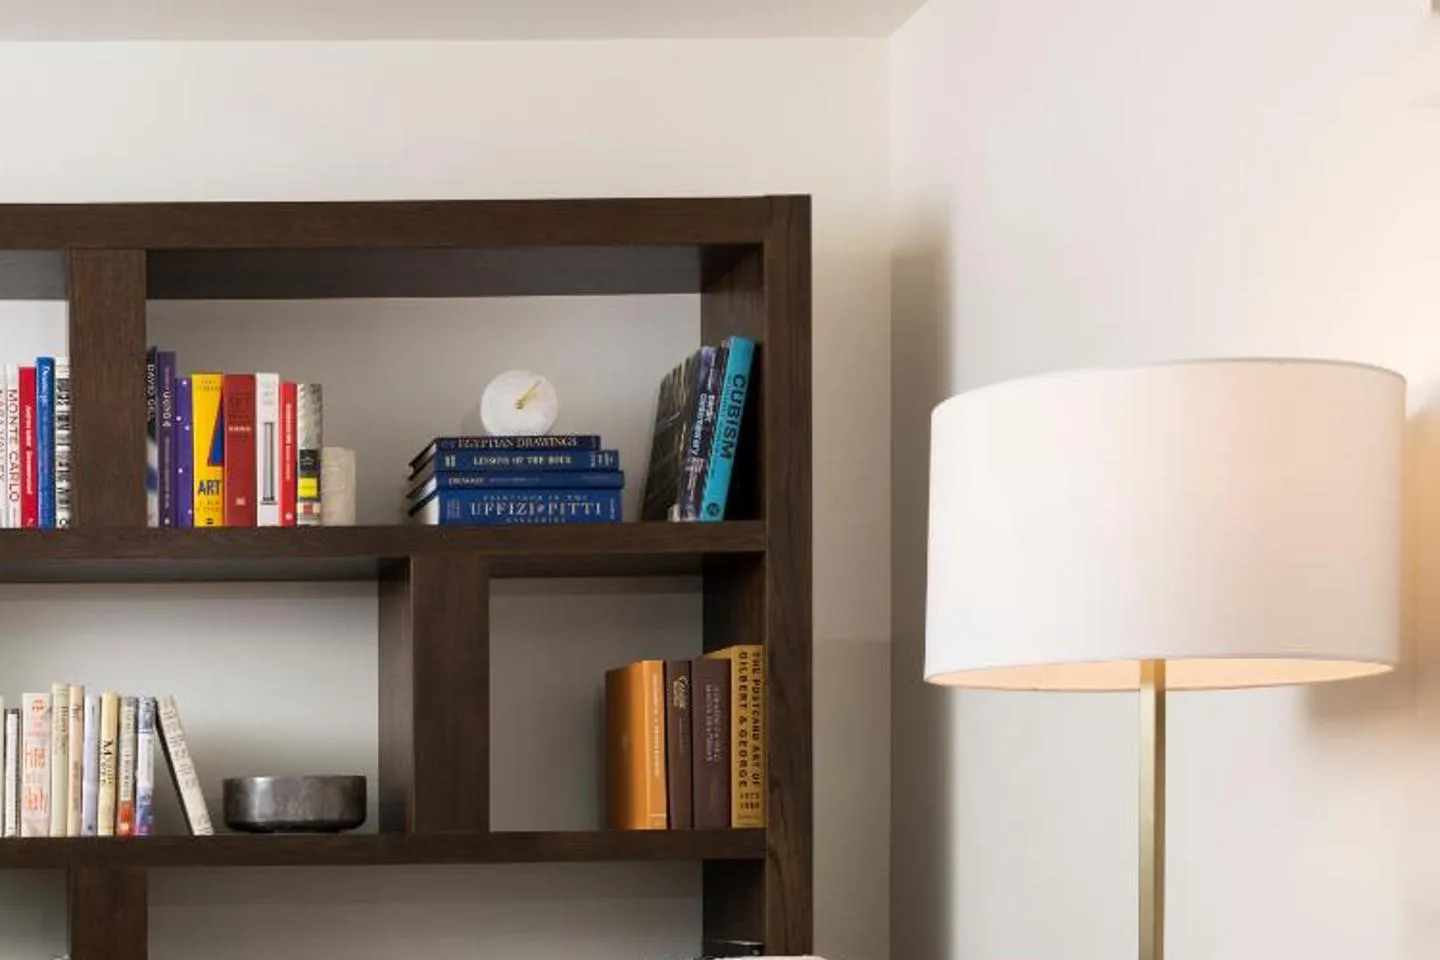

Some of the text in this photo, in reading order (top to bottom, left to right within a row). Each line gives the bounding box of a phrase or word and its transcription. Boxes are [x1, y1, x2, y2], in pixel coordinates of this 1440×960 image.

[8, 389, 20, 503] MONTE CARLO
[720, 373, 747, 460] CUBISM
[197, 480, 221, 496] ART
[471, 502, 535, 516] UFFIZI
[548, 502, 602, 516] PITTI
[738, 729, 748, 789] GEORGE
